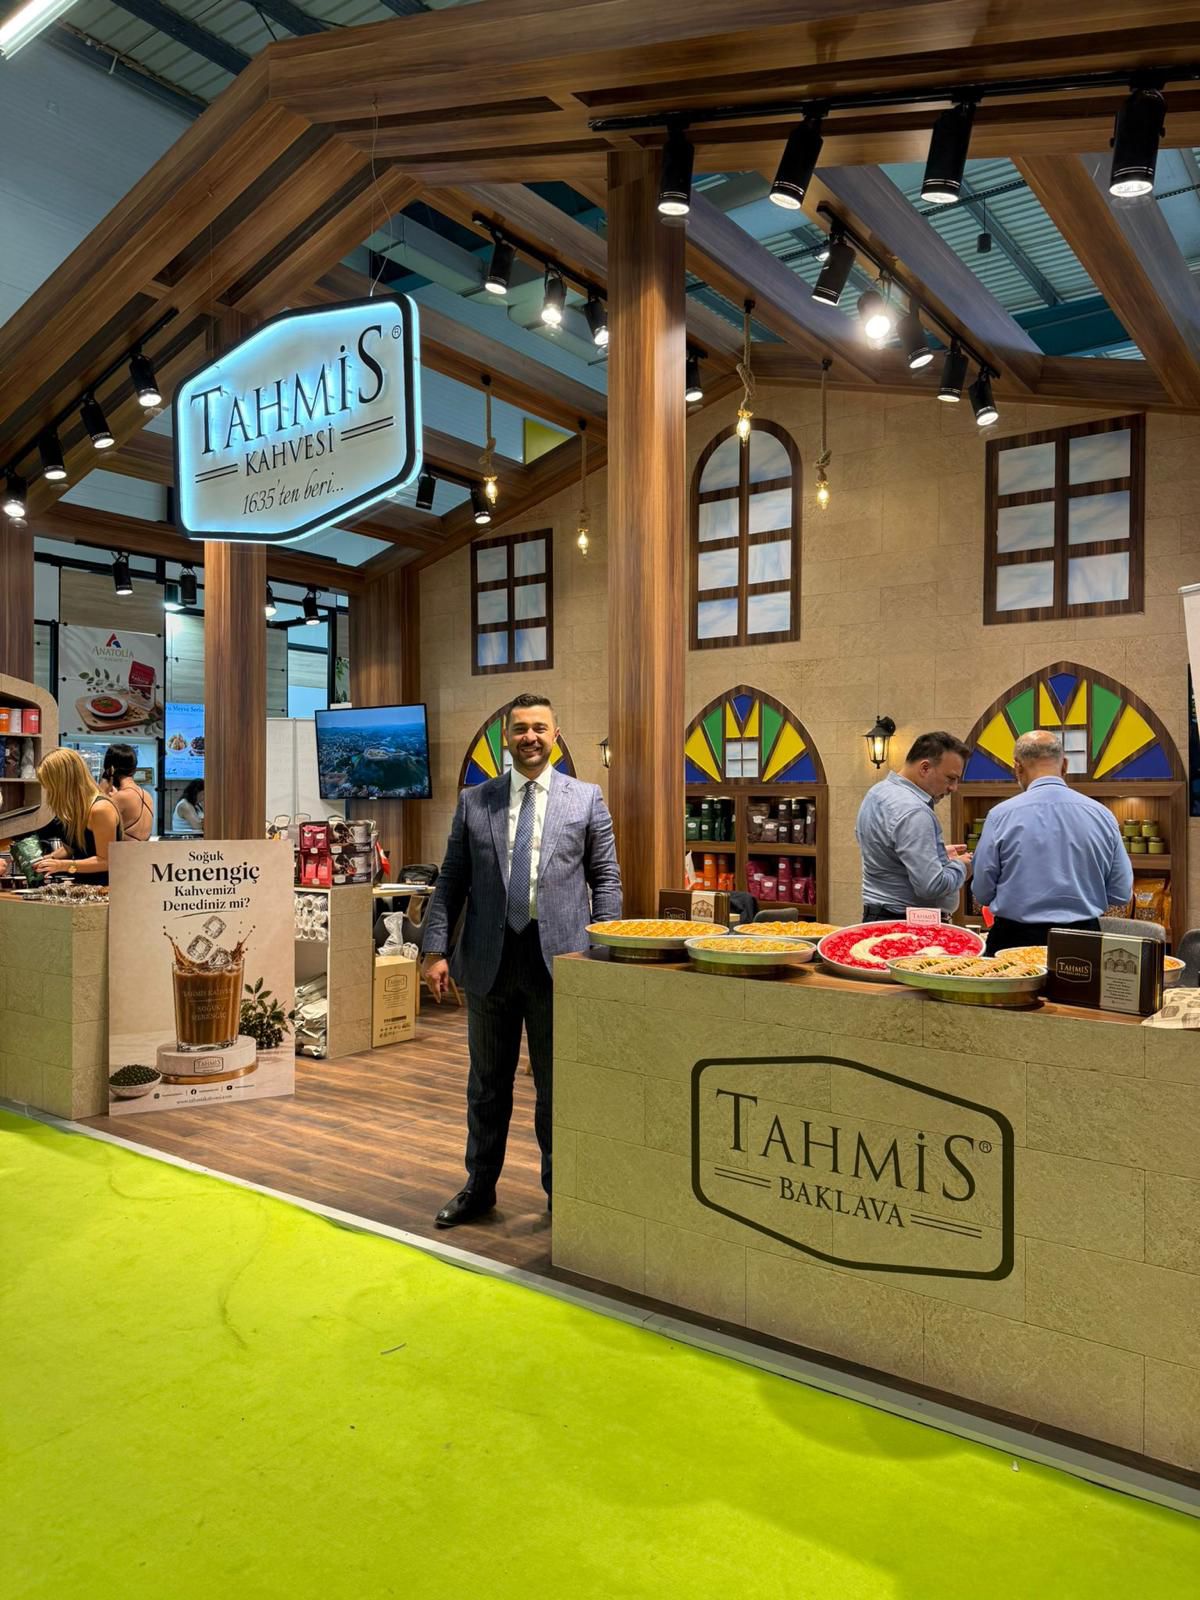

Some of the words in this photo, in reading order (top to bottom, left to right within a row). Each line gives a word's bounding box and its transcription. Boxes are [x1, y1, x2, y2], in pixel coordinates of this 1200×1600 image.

[191, 325, 384, 455] TAHMİS
[245, 423, 335, 477] KAHVESİ
[241, 478, 301, 515] 1635'ten
[304, 468, 344, 501] beri...
[151, 861, 261, 885] Menengiç
[188, 850, 224, 864] Soğuk
[162, 897, 226, 912] Denediniz
[229, 896, 251, 910] mi?
[174, 883, 237, 897] Kahvemizi
[716, 1088, 977, 1202] TAHMİS
[779, 1176, 905, 1229] BAKLAVA
